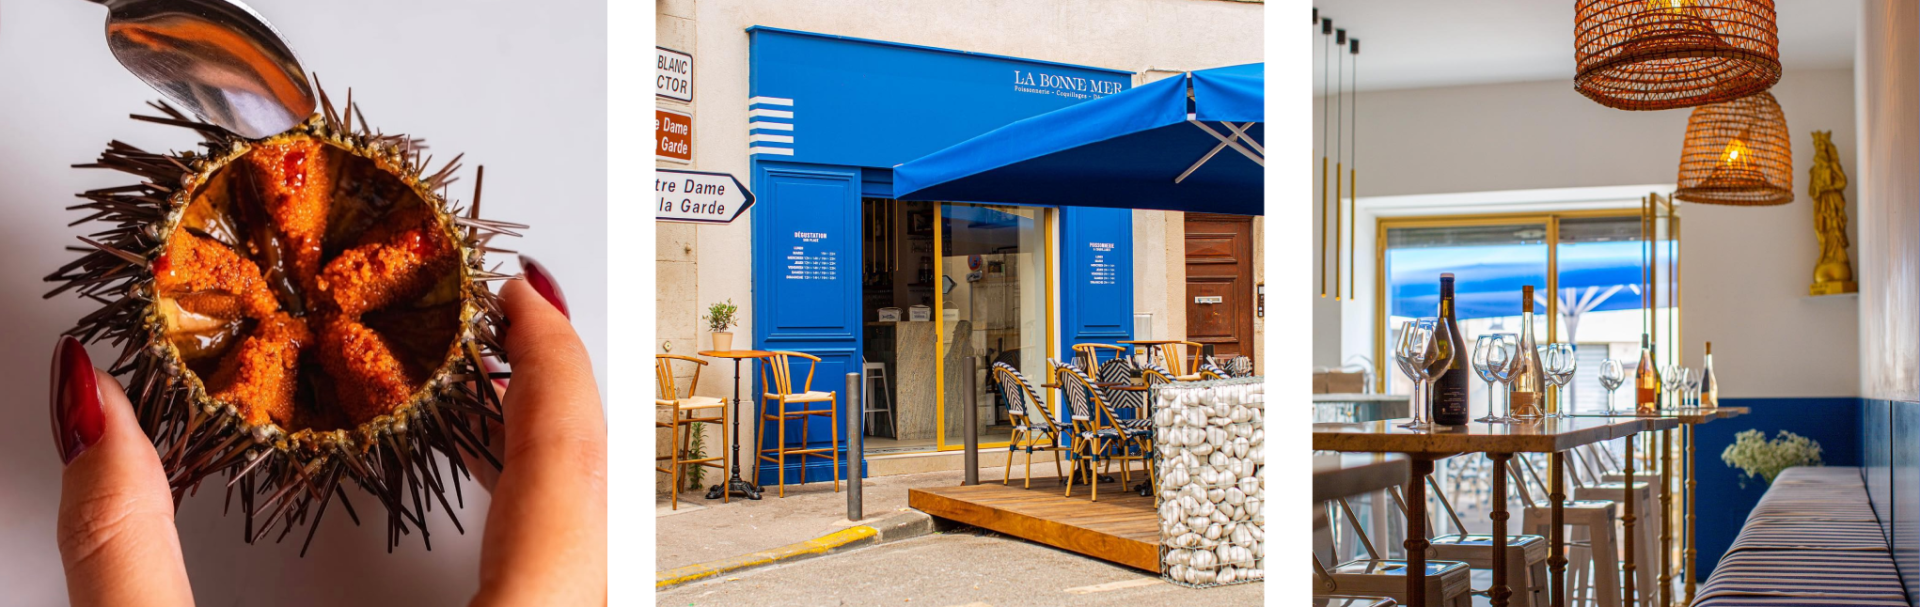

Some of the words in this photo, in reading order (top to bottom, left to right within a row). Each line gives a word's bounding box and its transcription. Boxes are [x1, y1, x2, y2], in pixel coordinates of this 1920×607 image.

[657, 55, 688, 75] BLANC
[656, 75, 688, 94] CTOR
[1014, 70, 1036, 86] LA
[1040, 73, 1087, 92] BONNE
[1090, 79, 1122, 95] MER
[1014, 85, 1050, 95] Poissonnerie
[1056, 90, 1087, 100] Coquillages
[663, 117, 688, 136] Dame
[661, 136, 688, 155] Garde
[684, 179, 725, 196] Dame
[659, 197, 673, 212] la
[681, 198, 725, 215] Garde
[794, 231, 828, 239] DÉGUSTATION
